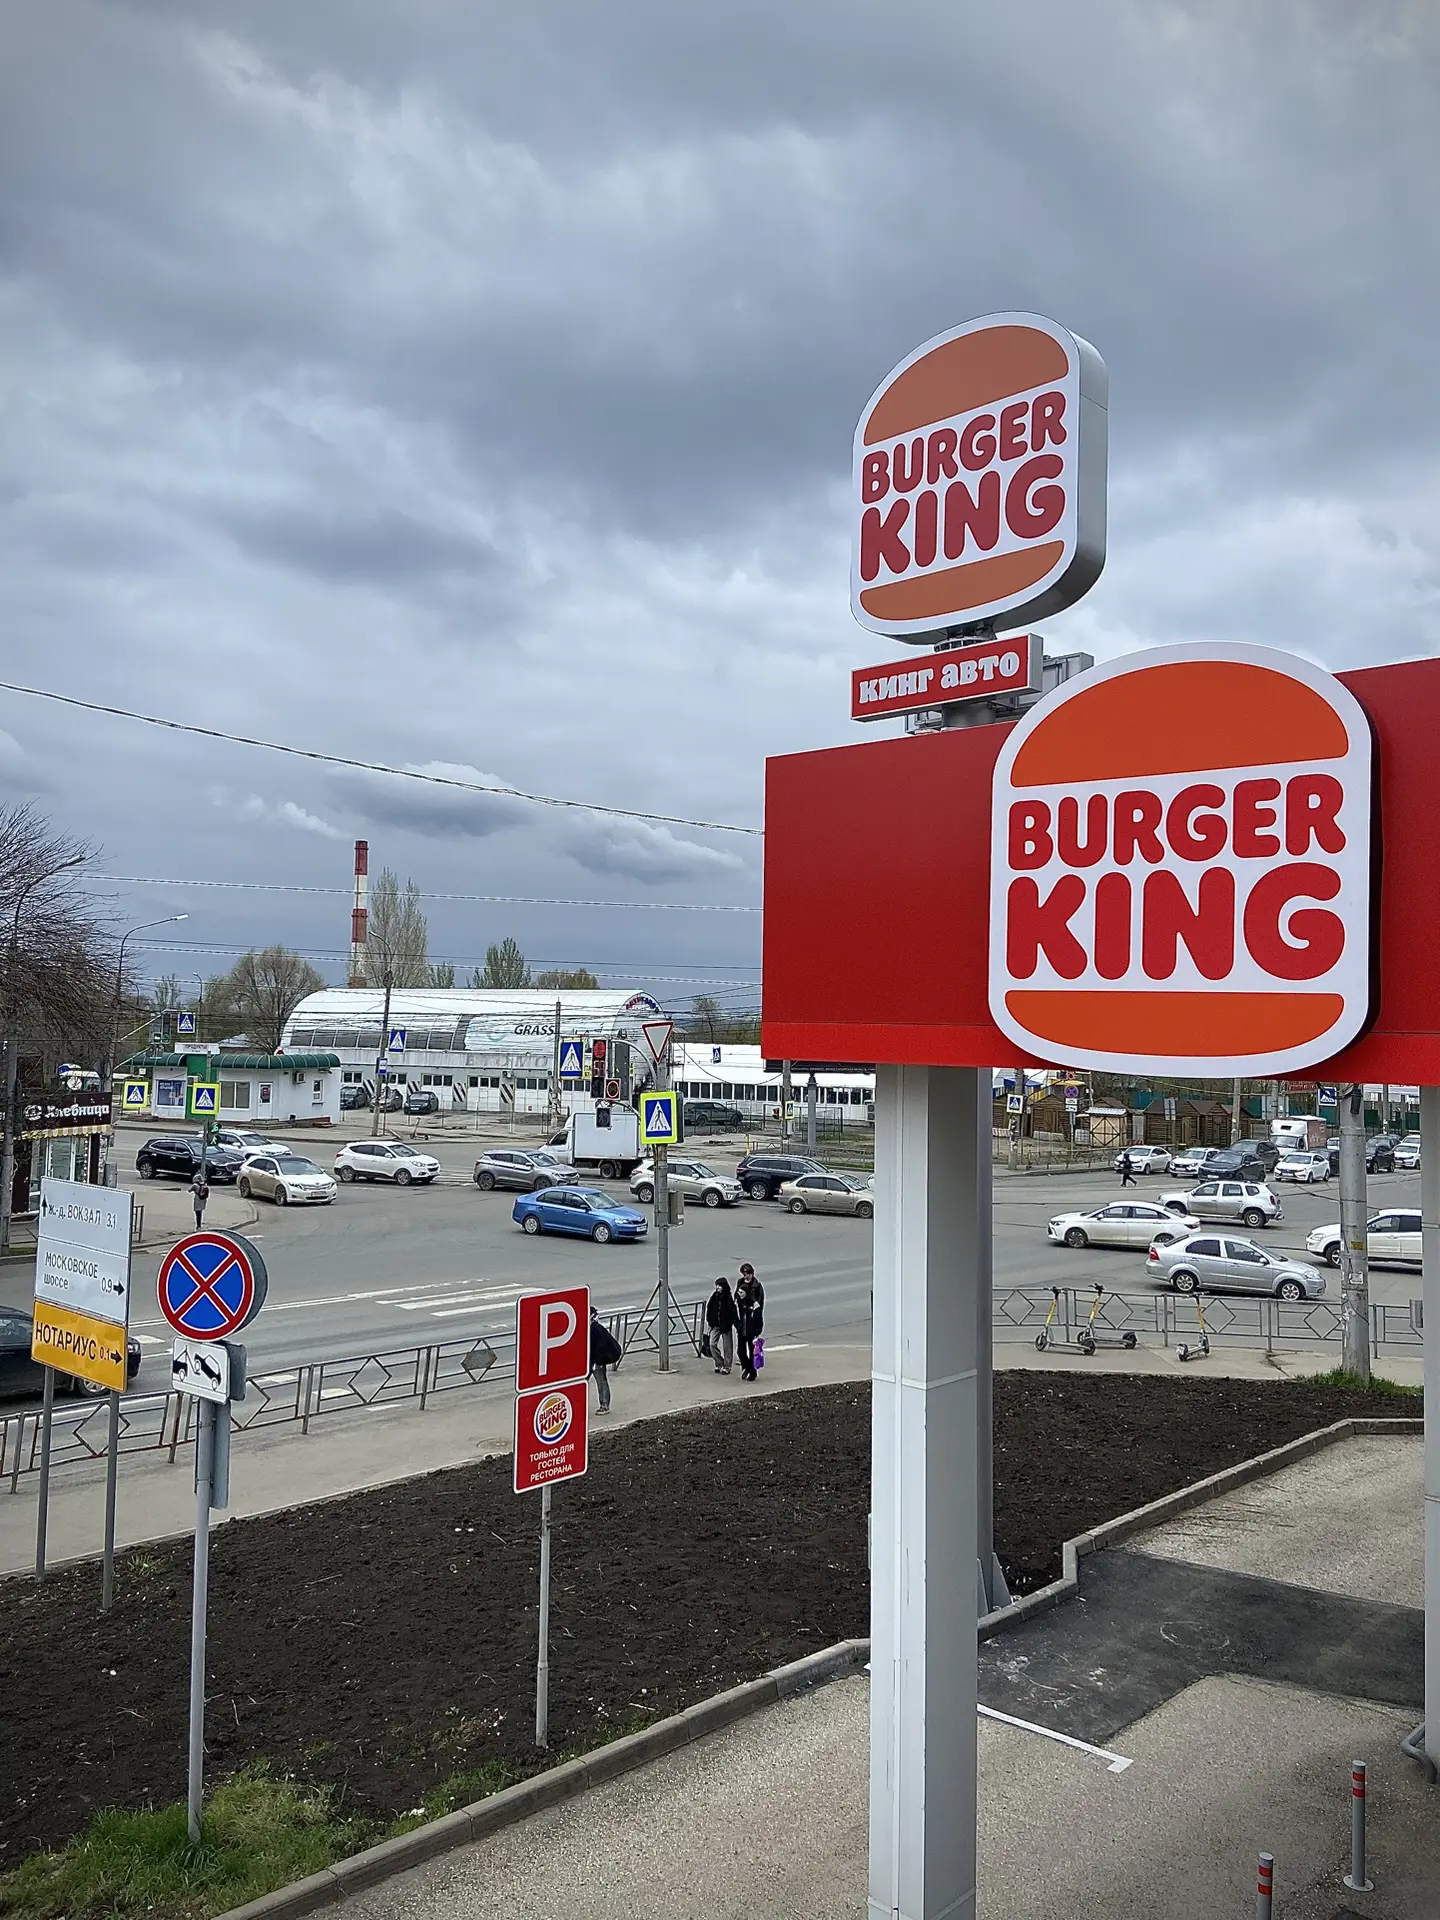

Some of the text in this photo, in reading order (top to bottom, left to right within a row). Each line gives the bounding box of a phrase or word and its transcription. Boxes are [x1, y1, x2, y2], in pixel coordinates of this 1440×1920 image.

[862, 390, 1067, 504] BURGER
[860, 454, 1067, 582] KING
[1007, 773, 1346, 870] BURGER
[1006, 862, 1346, 981] KING
[514, 1024, 555, 1036] GRASS
[67, 1204, 101, 1226] ВОКЗАЛ
[106, 1212, 117, 1229] 3.1
[45, 1251, 98, 1279] МОСКОВСКОЕ
[43, 1273, 69, 1290] шоссе
[101, 1277, 113, 1293] 0.9
[36, 1321, 111, 1361] НОТАРИУС 0.1
[538, 1400, 567, 1424] BURGER
[540, 1408, 568, 1435] KING
[529, 1442, 575, 1463] ТОЛЬКО ДЛЯ
[537, 1453, 566, 1470] ГОСТЕЙ
[530, 1463, 573, 1482] РЕСТОРАНА
